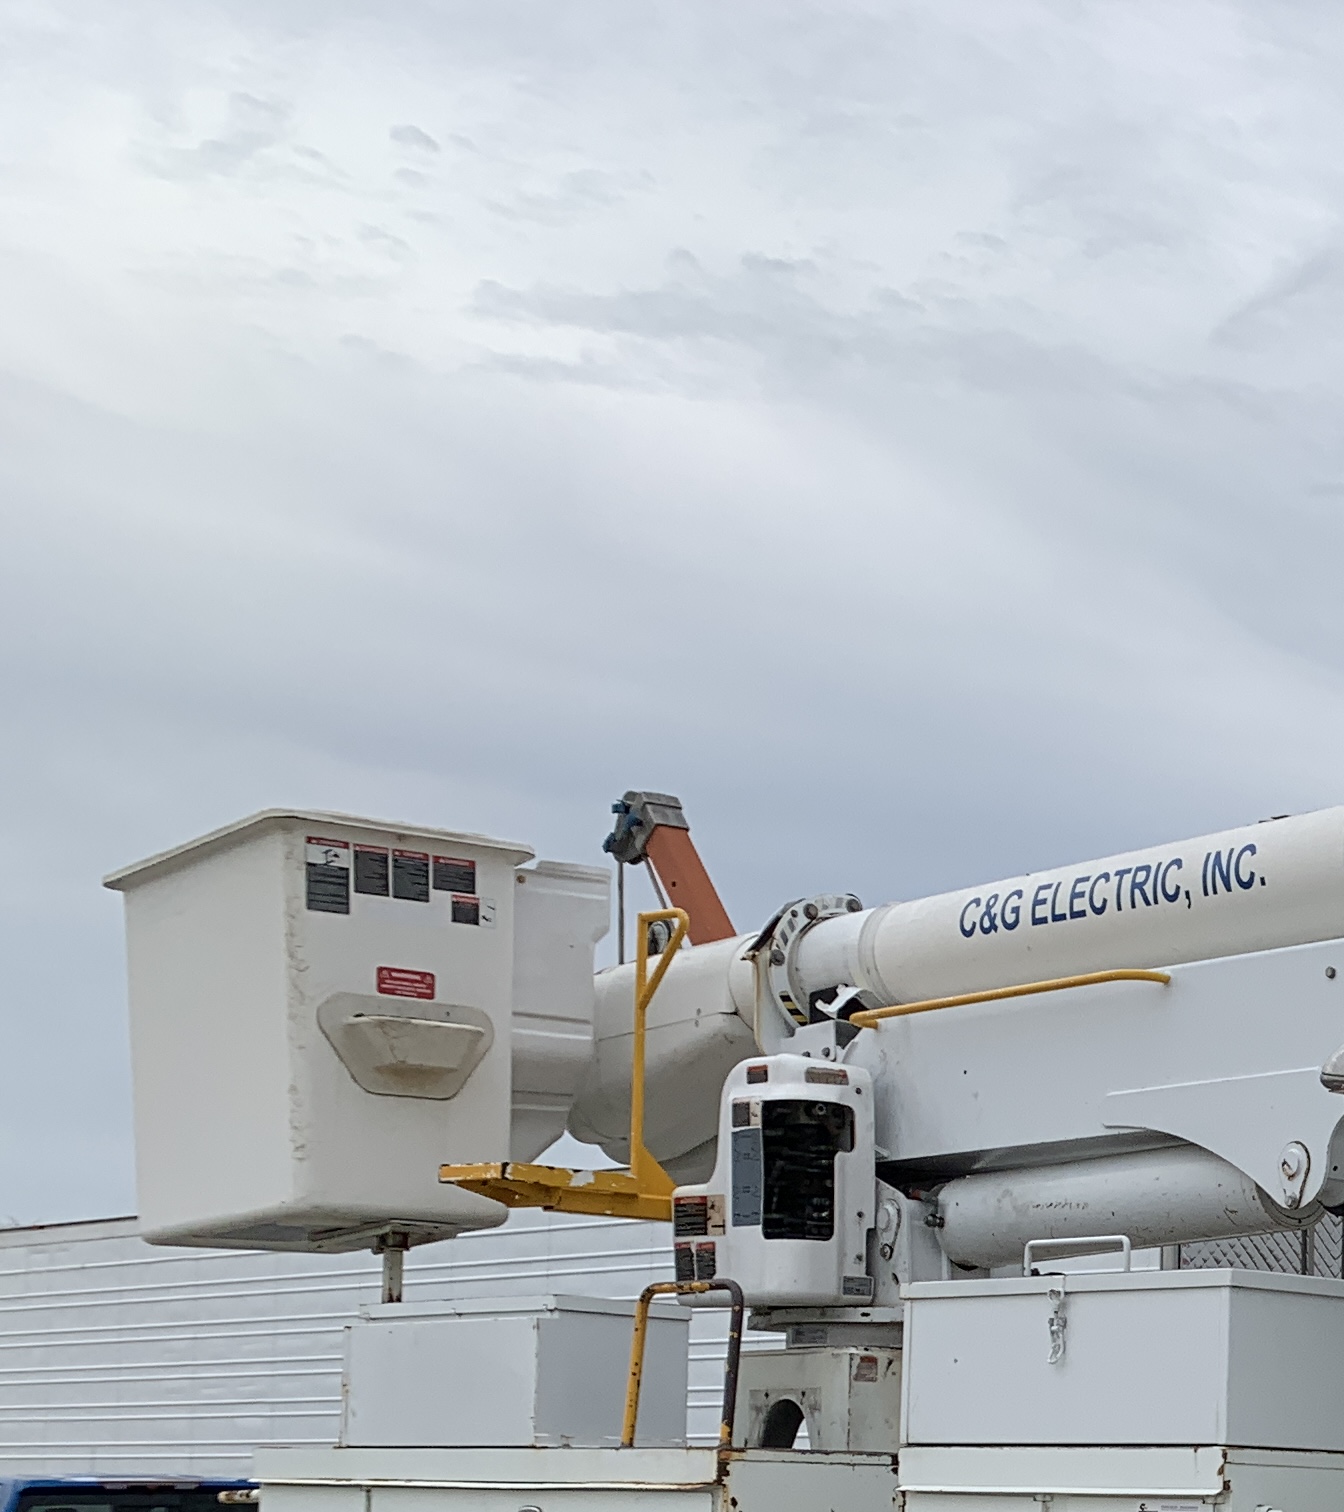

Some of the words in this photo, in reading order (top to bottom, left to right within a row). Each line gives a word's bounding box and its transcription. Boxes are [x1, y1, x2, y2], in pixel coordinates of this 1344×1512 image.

[959, 889, 1023, 938] C&G
[1031, 858, 1192, 926] ELECTRIC,
[1202, 843, 1266, 897] INC.
